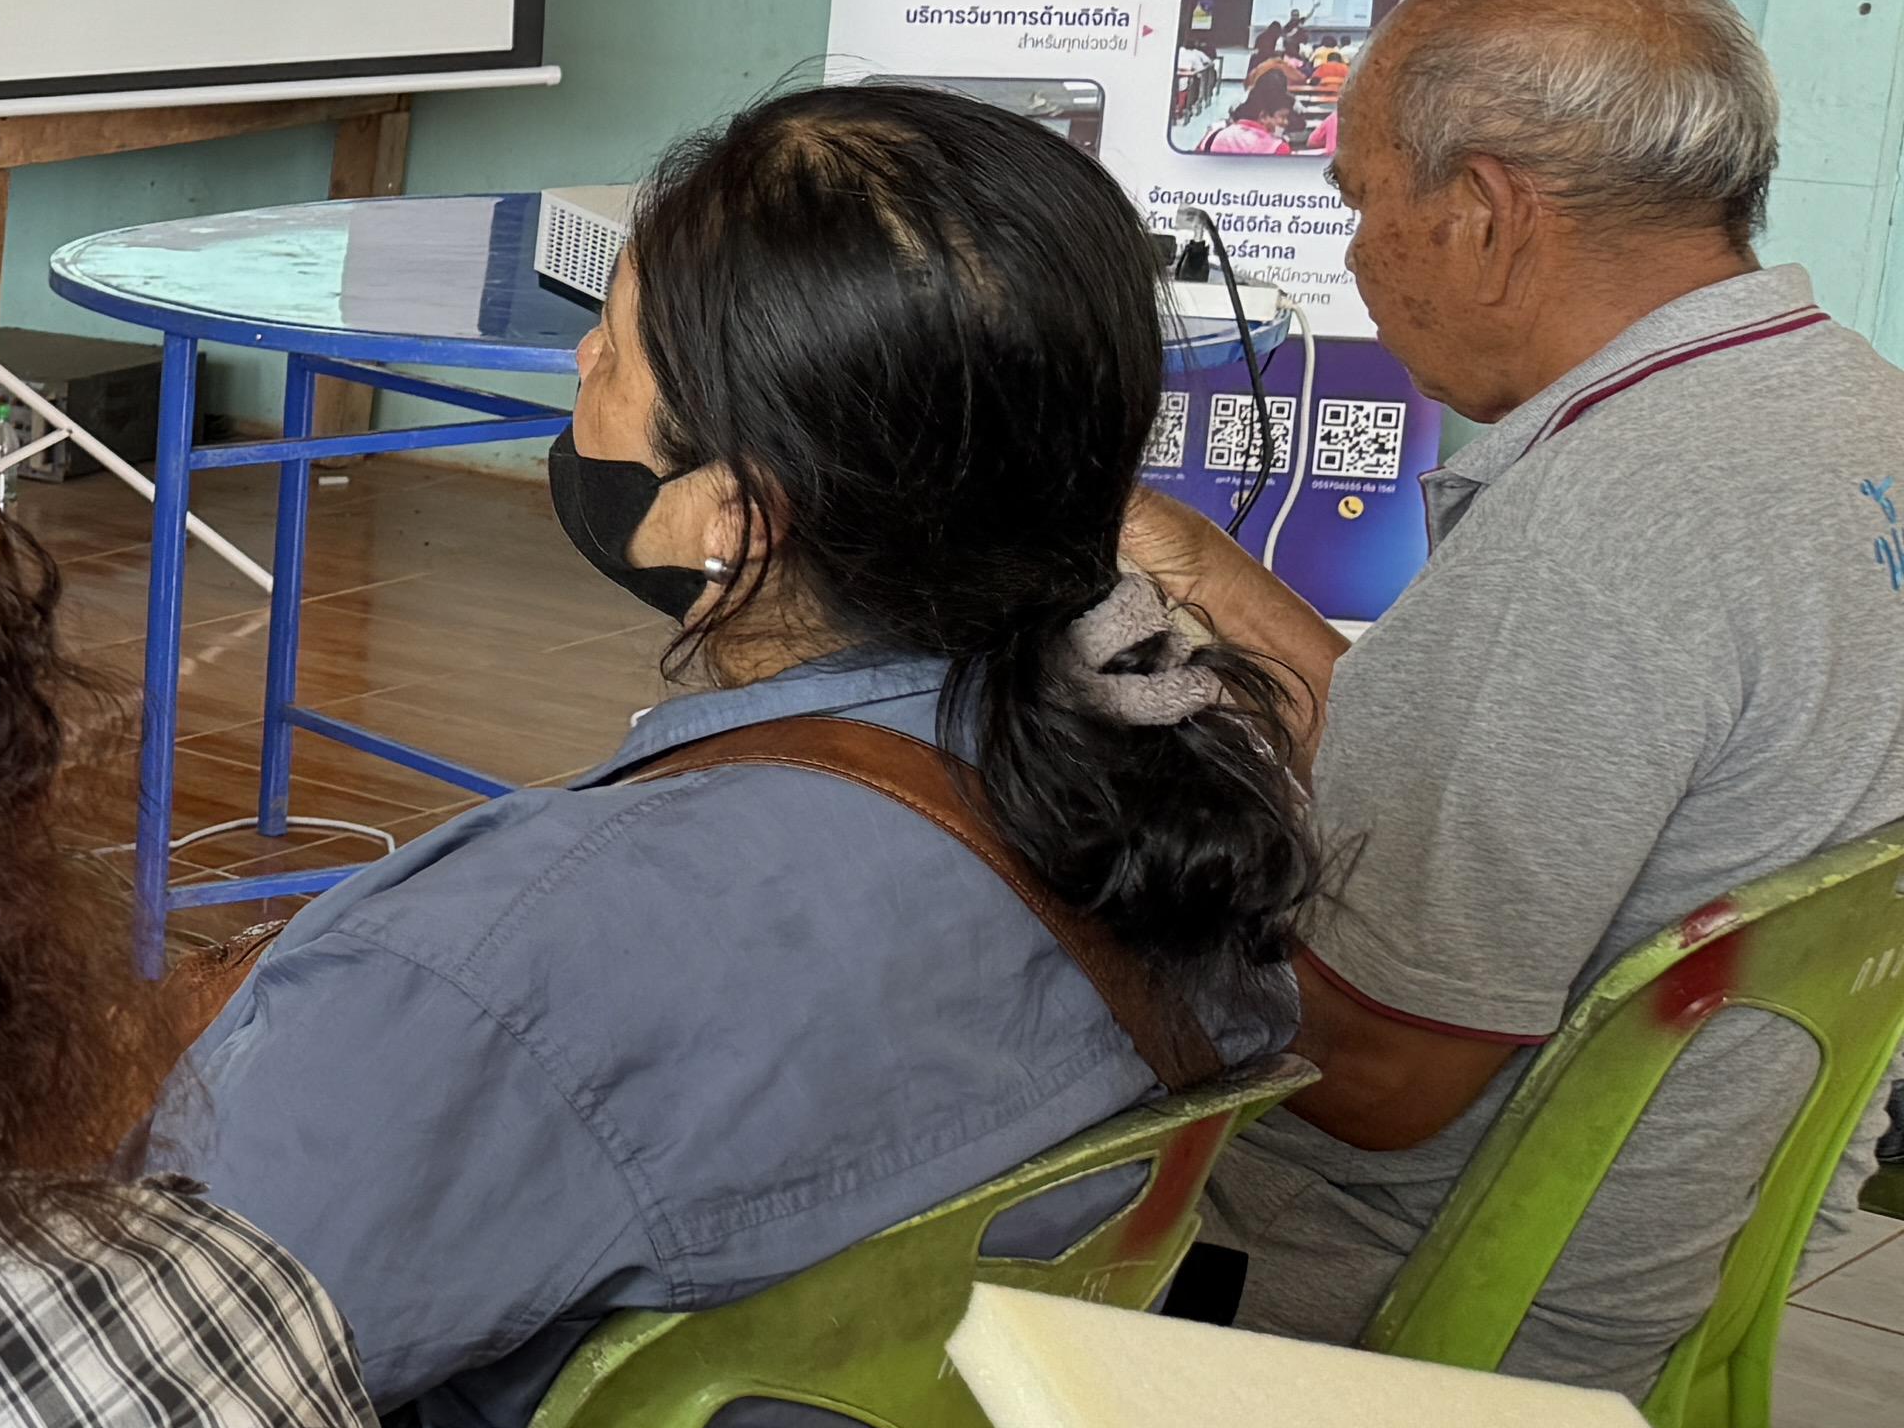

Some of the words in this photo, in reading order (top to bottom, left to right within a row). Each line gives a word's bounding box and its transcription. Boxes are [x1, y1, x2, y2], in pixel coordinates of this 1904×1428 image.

[905, 5, 1130, 27] บริการวิชาการด้านดิจิทัล
[1018, 33, 1128, 53] สำหรับทุกช่วงวัย
